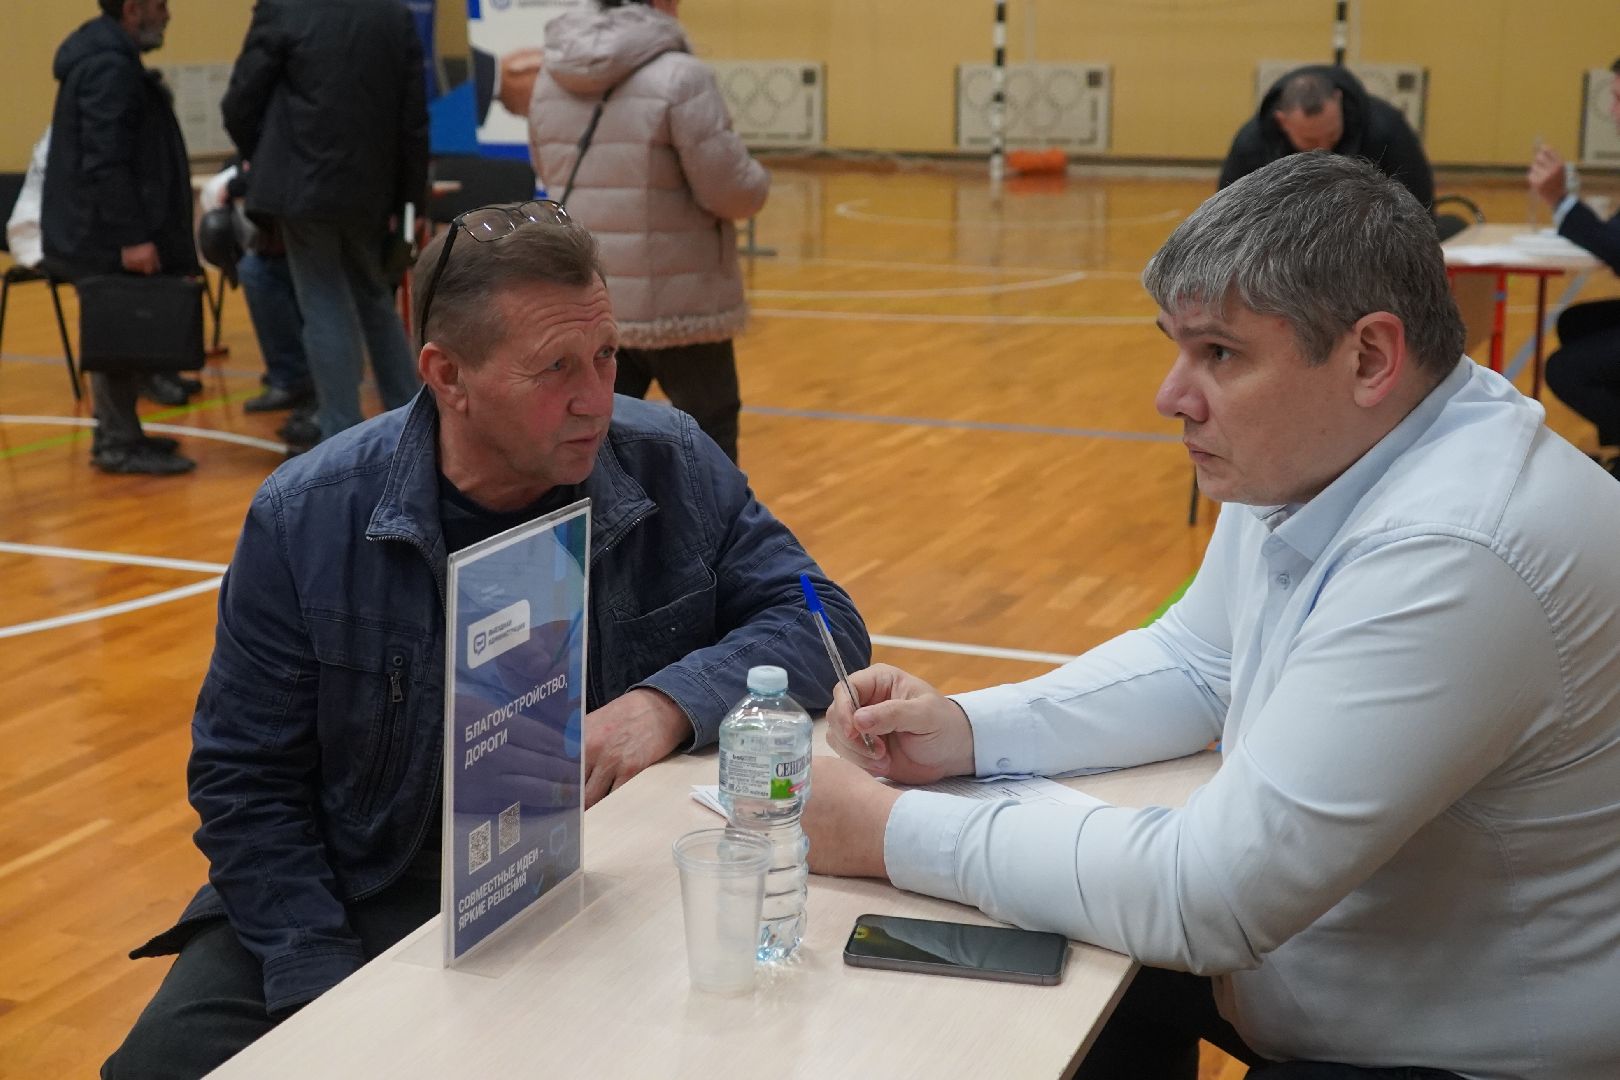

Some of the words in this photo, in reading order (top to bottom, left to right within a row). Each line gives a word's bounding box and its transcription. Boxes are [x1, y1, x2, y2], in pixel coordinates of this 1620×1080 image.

[465, 674, 568, 743] БЛАГОУСТРОЙСТВО,
[464, 728, 508, 770] ДОРОГИ
[458, 863, 516, 914] СОВМЕСТНЫЕ
[516, 847, 539, 874] ИДЕИ
[458, 900, 487, 932] ЯРКИЕ
[487, 872, 527, 911] РЕШЕНИЯ
